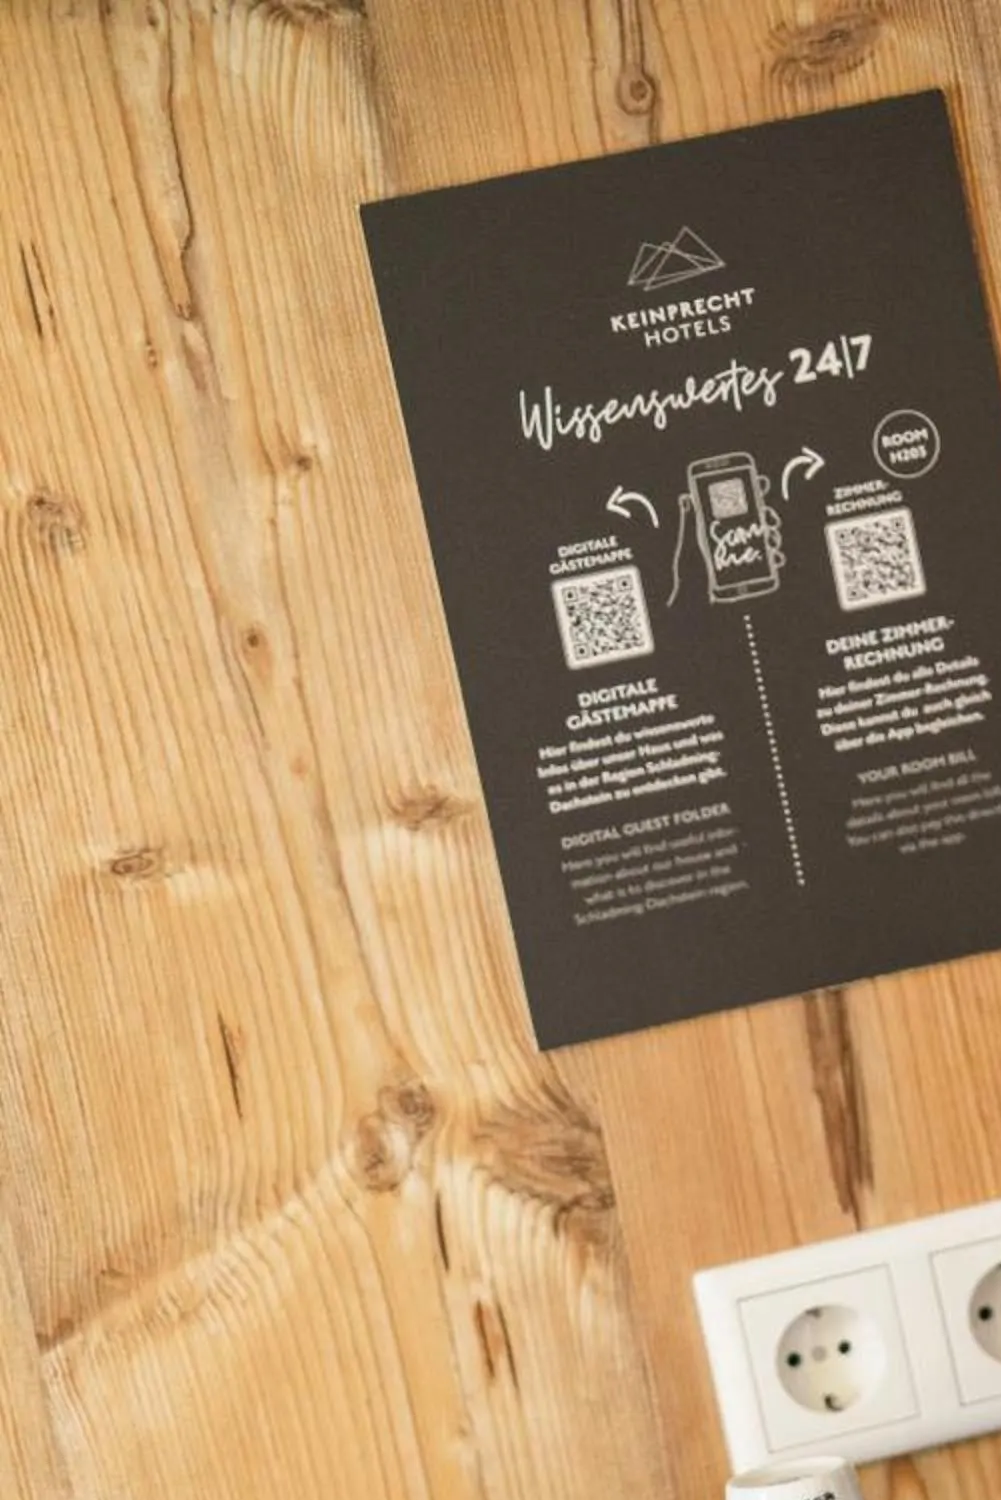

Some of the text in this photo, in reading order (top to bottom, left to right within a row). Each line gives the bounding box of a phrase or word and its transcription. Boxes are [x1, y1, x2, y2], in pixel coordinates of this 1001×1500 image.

[611, 288, 755, 332] KEINPRECHT
[644, 315, 732, 347] HOTELS
[519, 334, 872, 451] Wissenswertes 24|7
[881, 427, 929, 448] ROOM
[825, 490, 903, 516] RECHNUNG
[549, 547, 633, 575] GÄSTEMAPPE
[557, 535, 619, 558] DIGITALE
[826, 616, 955, 655] DEINE ZIMMER-
[843, 636, 945, 671] RECHNUNG
[577, 678, 658, 708] DIGITALE
[566, 694, 679, 731] GÄSTEMAPPE
[857, 766, 899, 784] YOUR
[901, 755, 946, 774] ROOM
[561, 803, 730, 850] DIGITAL GUEST FOLDER
